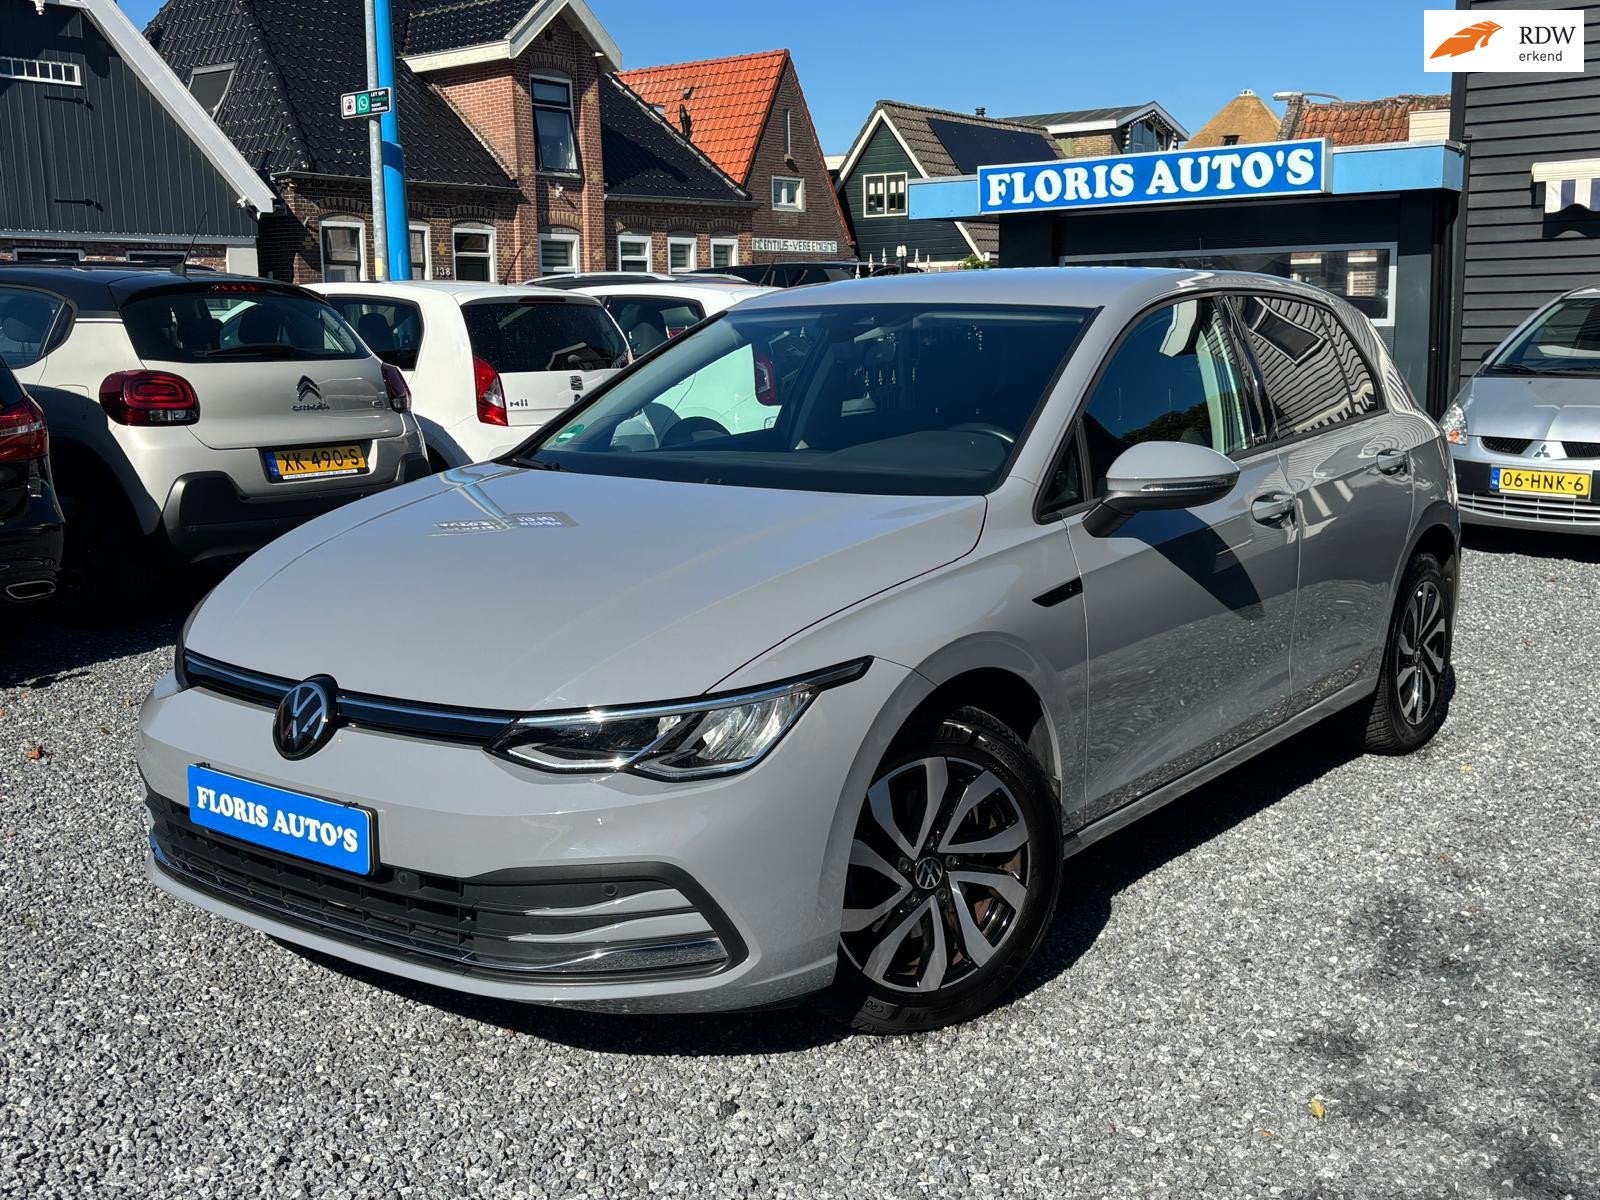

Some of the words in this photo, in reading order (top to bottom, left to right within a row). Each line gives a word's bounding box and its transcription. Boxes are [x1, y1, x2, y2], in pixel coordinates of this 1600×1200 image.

[987, 163, 1135, 206] FLORIS
[1145, 148, 1315, 195] AUTO'S
[436, 266, 451, 276] 138
[281, 448, 360, 472] XK-490-S
[1502, 471, 1584, 492] 06-HNK-6
[196, 786, 269, 828] FLORIS
[272, 809, 359, 853] AUTO'S
